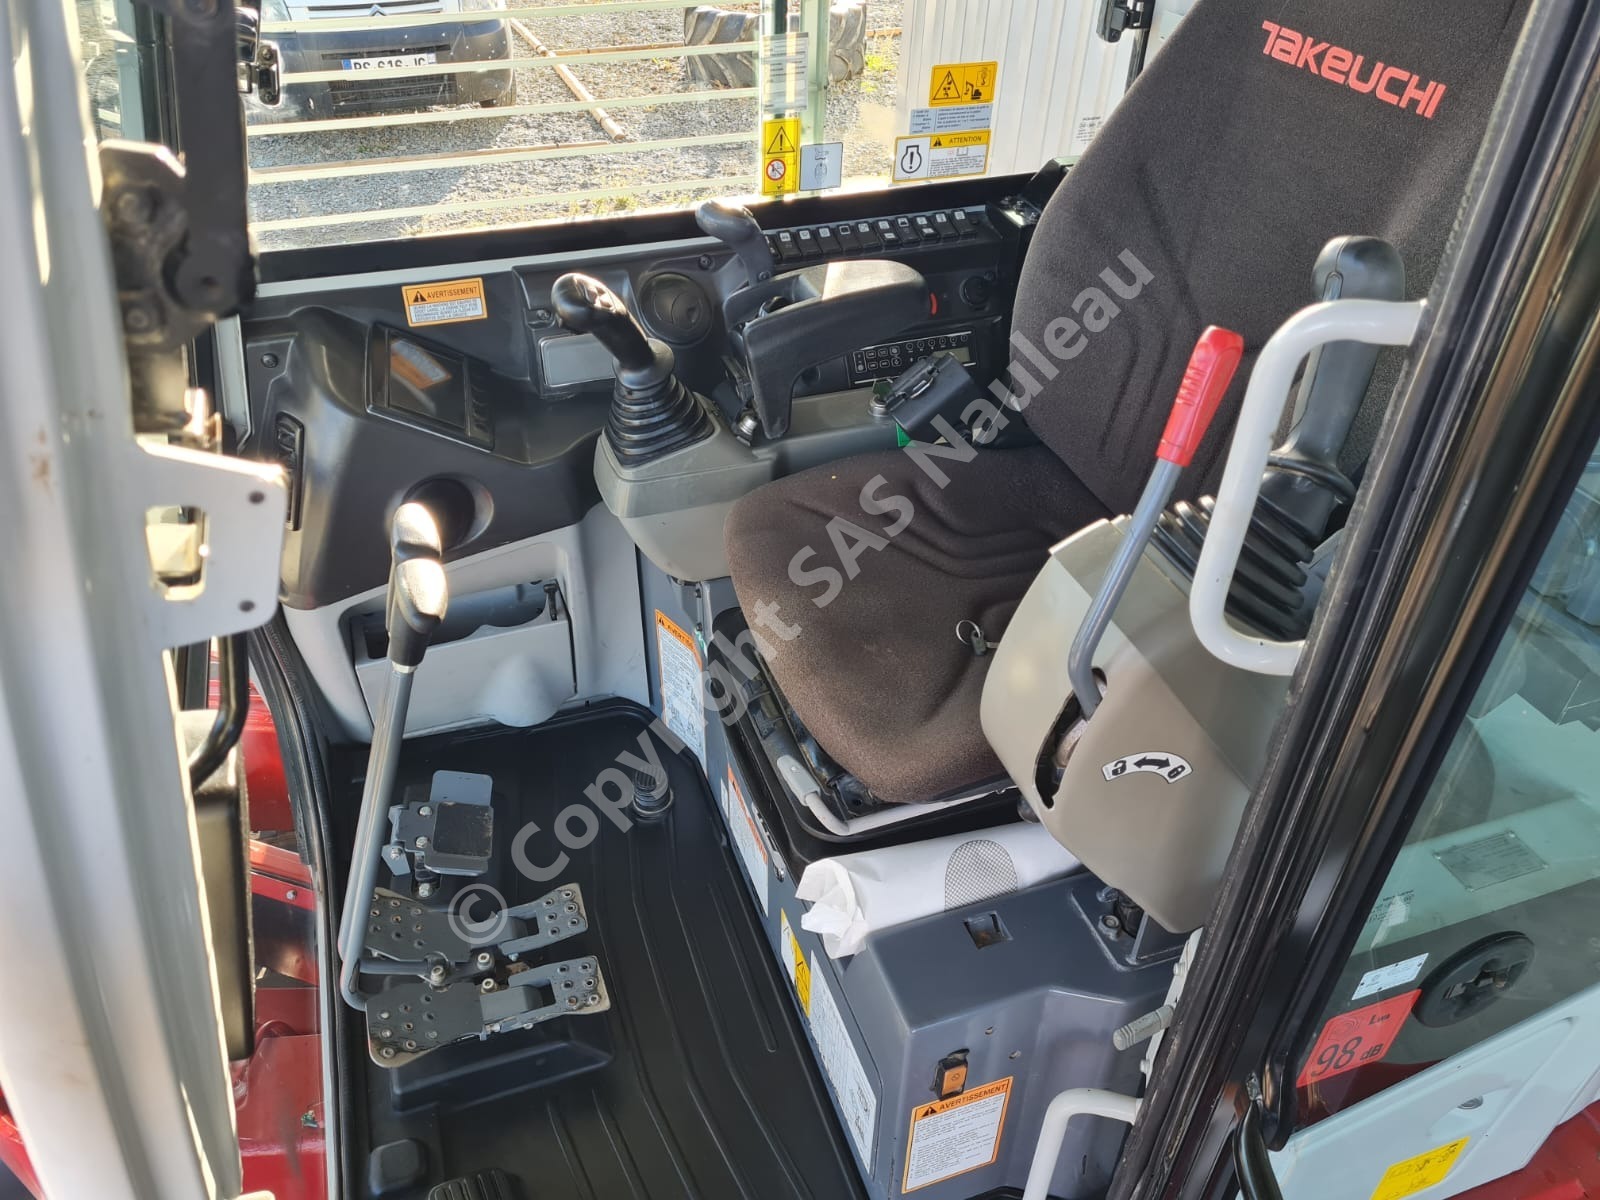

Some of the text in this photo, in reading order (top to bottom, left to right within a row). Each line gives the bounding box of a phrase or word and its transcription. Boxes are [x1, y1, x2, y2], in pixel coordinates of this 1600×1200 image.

[948, 136, 982, 144] ATTENTION
[427, 286, 477, 299] AVERTISSEMENT
[1310, 1036, 1384, 1077] 98 dB
[939, 1084, 1006, 1110] AVERTISSEMENT
